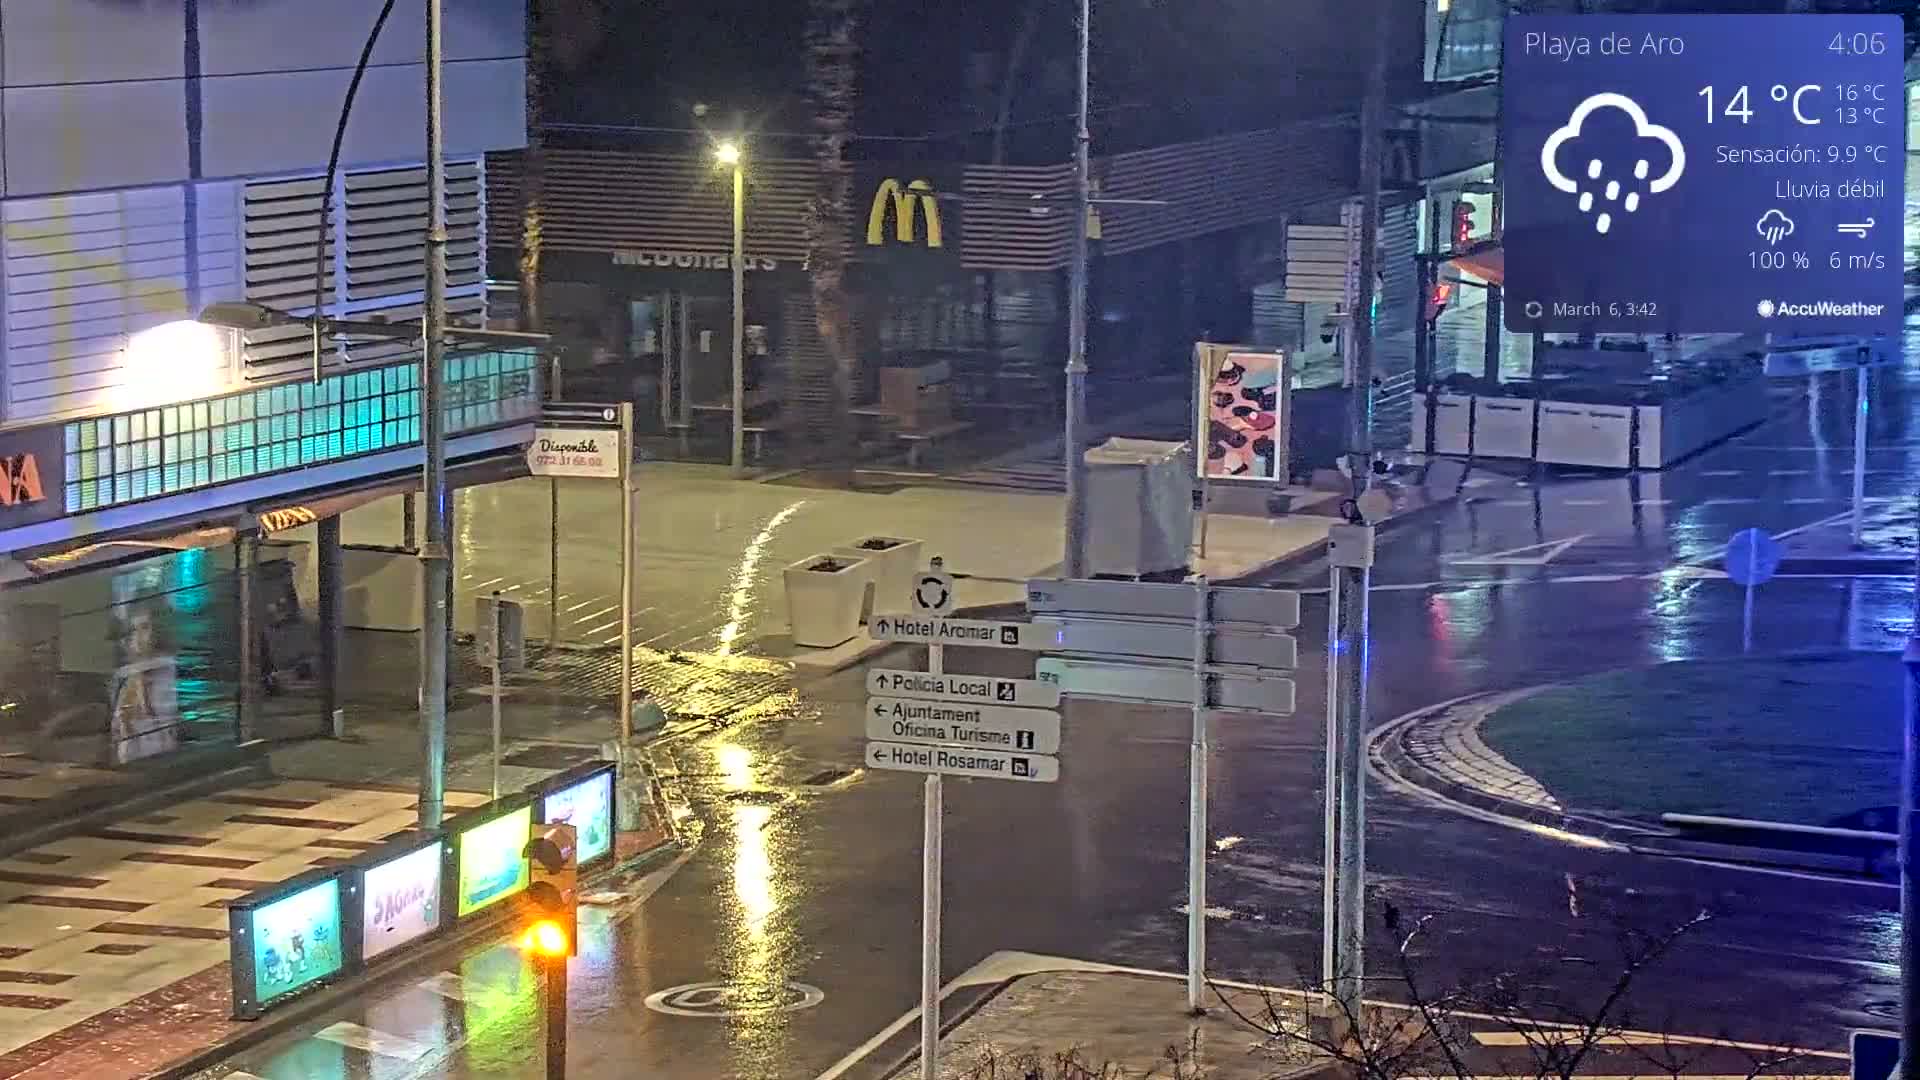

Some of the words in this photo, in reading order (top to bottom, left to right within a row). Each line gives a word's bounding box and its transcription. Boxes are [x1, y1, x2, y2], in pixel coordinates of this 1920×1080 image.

[539, 438, 599, 459] Disponible
[894, 619, 934, 637] Hotel
[941, 623, 996, 640] Aromar
[893, 675, 945, 694] Policia
[950, 679, 991, 697] Local
[892, 703, 980, 723] Ajuntament
[893, 721, 946, 739] Oficina
[951, 725, 1011, 744] Turisme
[892, 747, 932, 766] Hotel
[937, 752, 1005, 771] Rosamar
